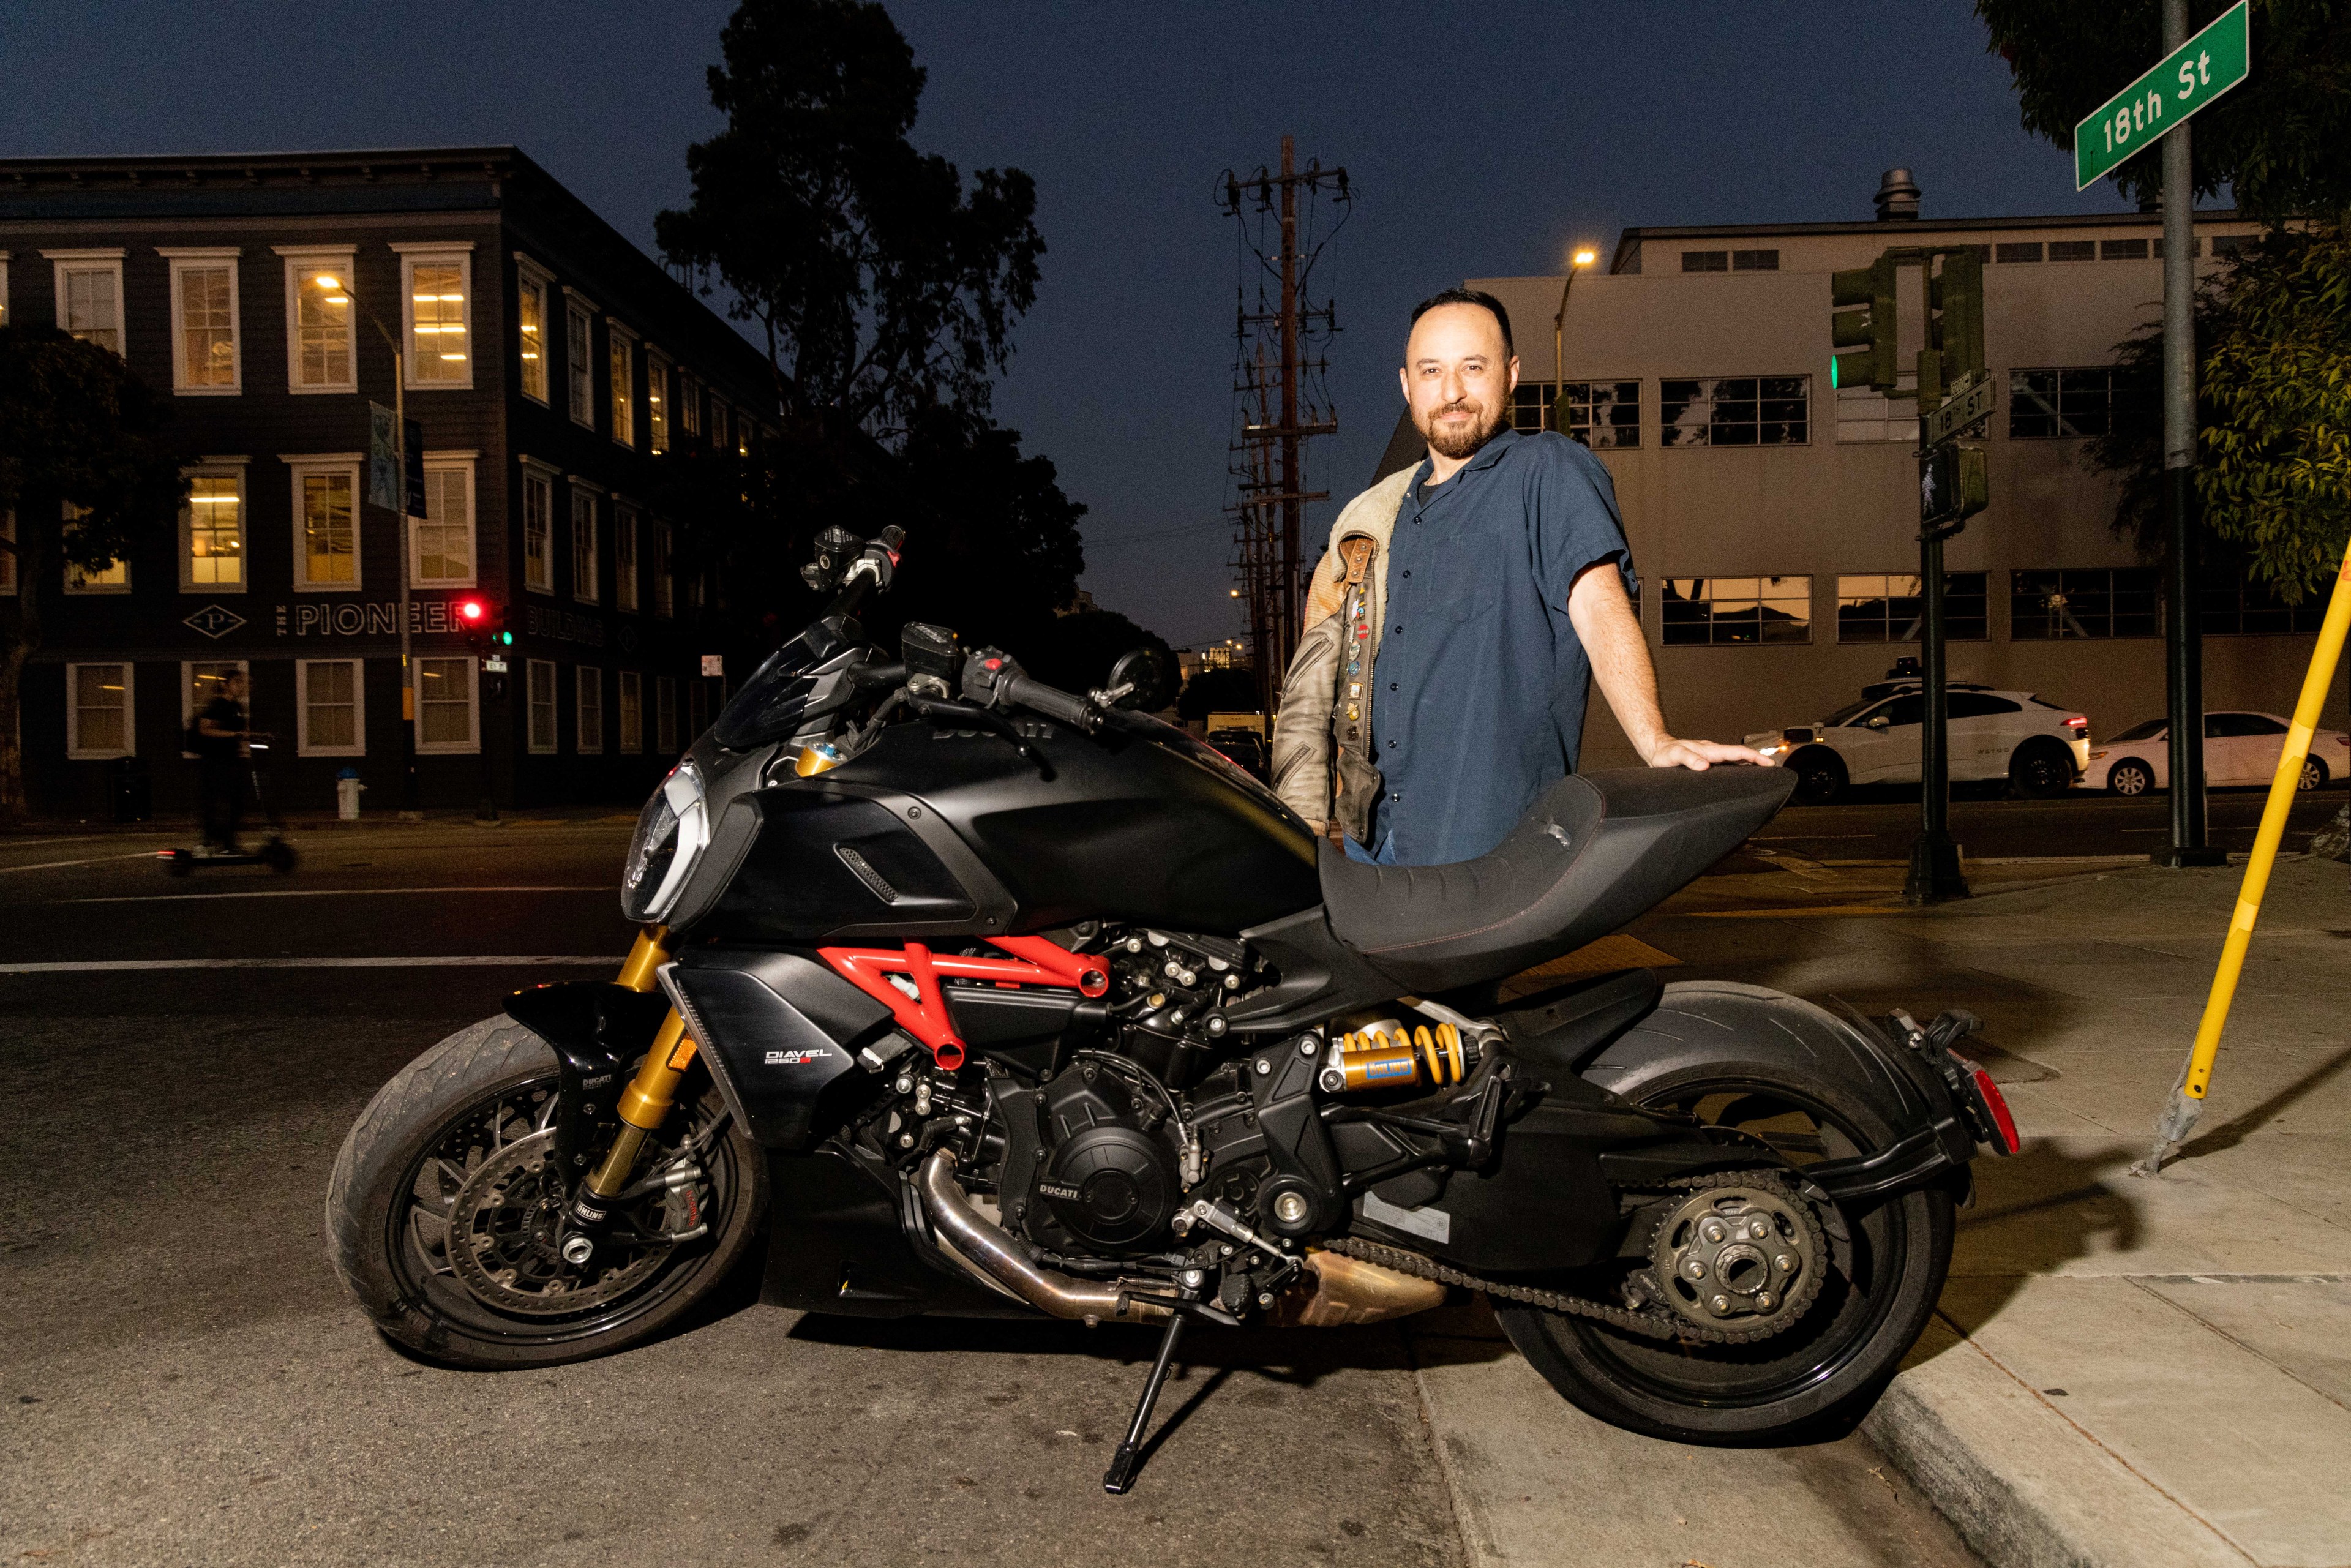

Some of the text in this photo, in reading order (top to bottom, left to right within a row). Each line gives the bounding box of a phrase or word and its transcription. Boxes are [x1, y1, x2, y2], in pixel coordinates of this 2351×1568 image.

[2104, 49, 2211, 154] 18th St
[1940, 389, 1982, 432] 18TH ST
[208, 612, 225, 630] P
[276, 604, 287, 636] THE
[765, 1049, 833, 1059] DIAVEL
[582, 1073, 612, 1086] DUCATI
[1039, 1184, 1078, 1199] DUCATI
[577, 1202, 604, 1220] ÖHLINS
[685, 1189, 699, 1228] brembo
